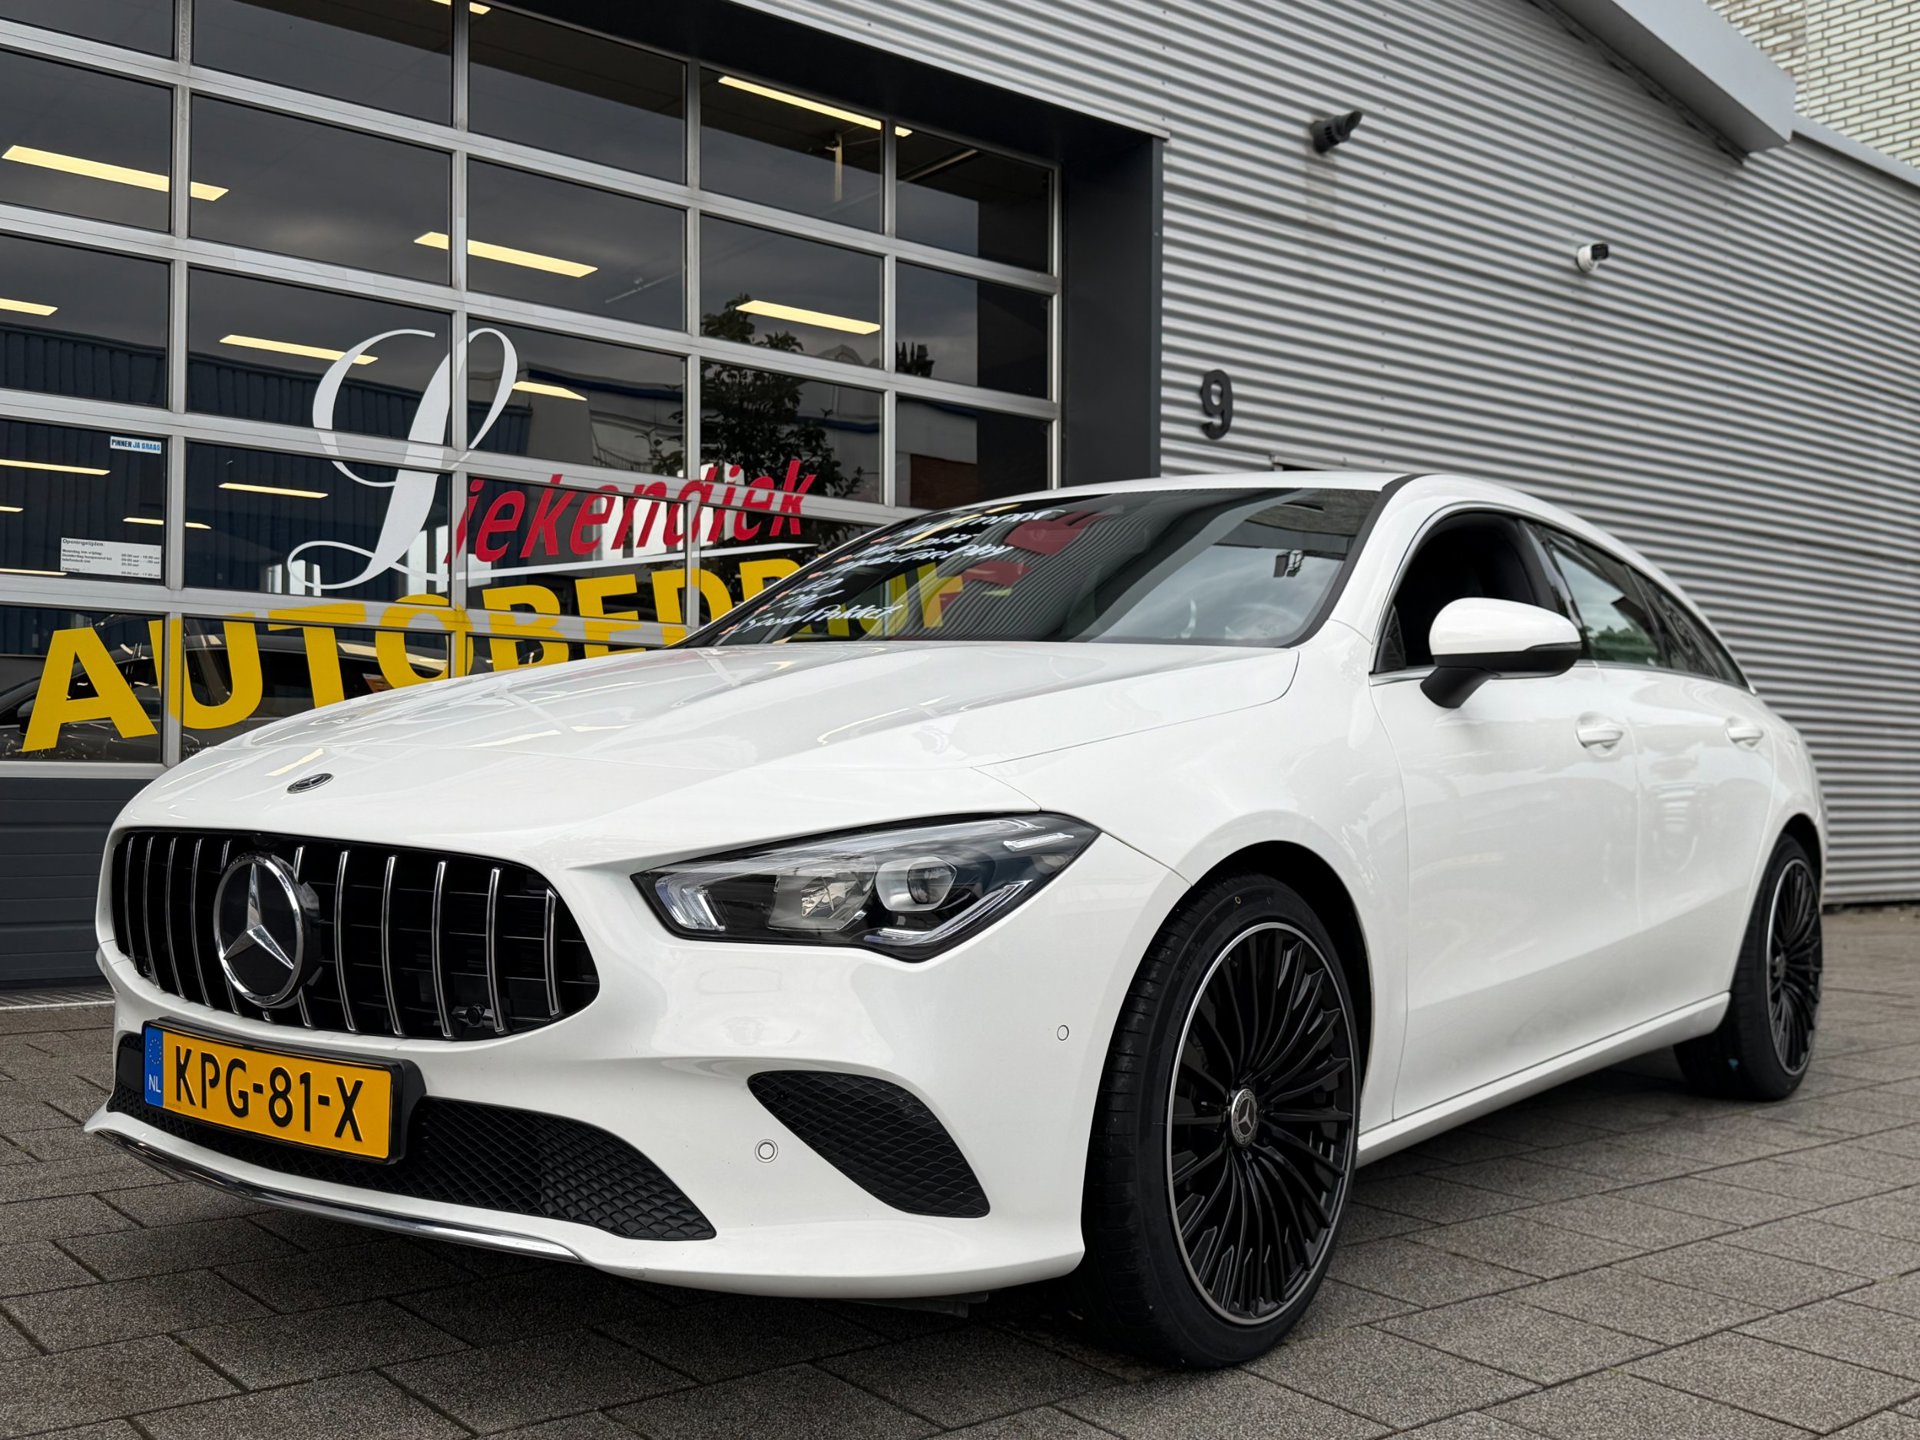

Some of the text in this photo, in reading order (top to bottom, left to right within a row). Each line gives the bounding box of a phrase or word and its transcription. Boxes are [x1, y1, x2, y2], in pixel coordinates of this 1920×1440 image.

[1200, 369, 1233, 440] 9
[148, 1074, 161, 1093] NL
[175, 1045, 363, 1142] KPG-81-X
